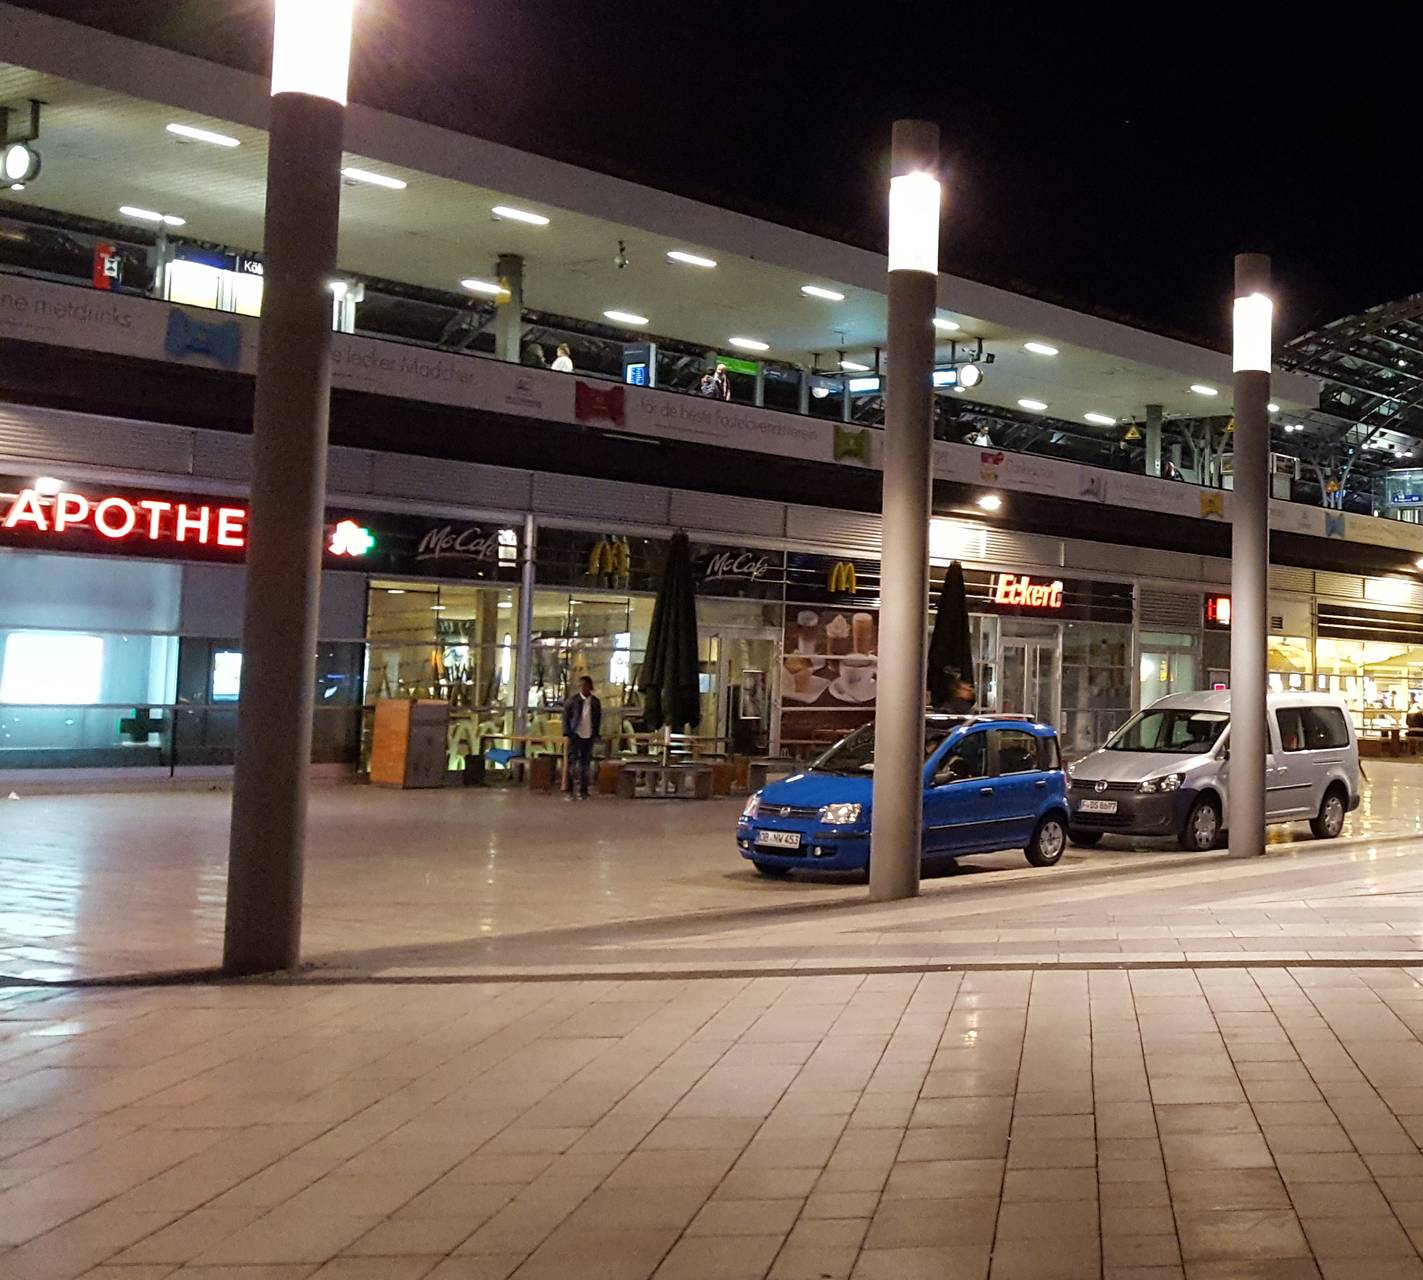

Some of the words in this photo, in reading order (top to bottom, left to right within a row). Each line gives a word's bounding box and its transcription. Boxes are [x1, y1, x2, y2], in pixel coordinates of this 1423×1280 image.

[244, 259, 263, 275] Köl
[6, 489, 247, 547] APOTHE
[996, 573, 1063, 608] Eckert
